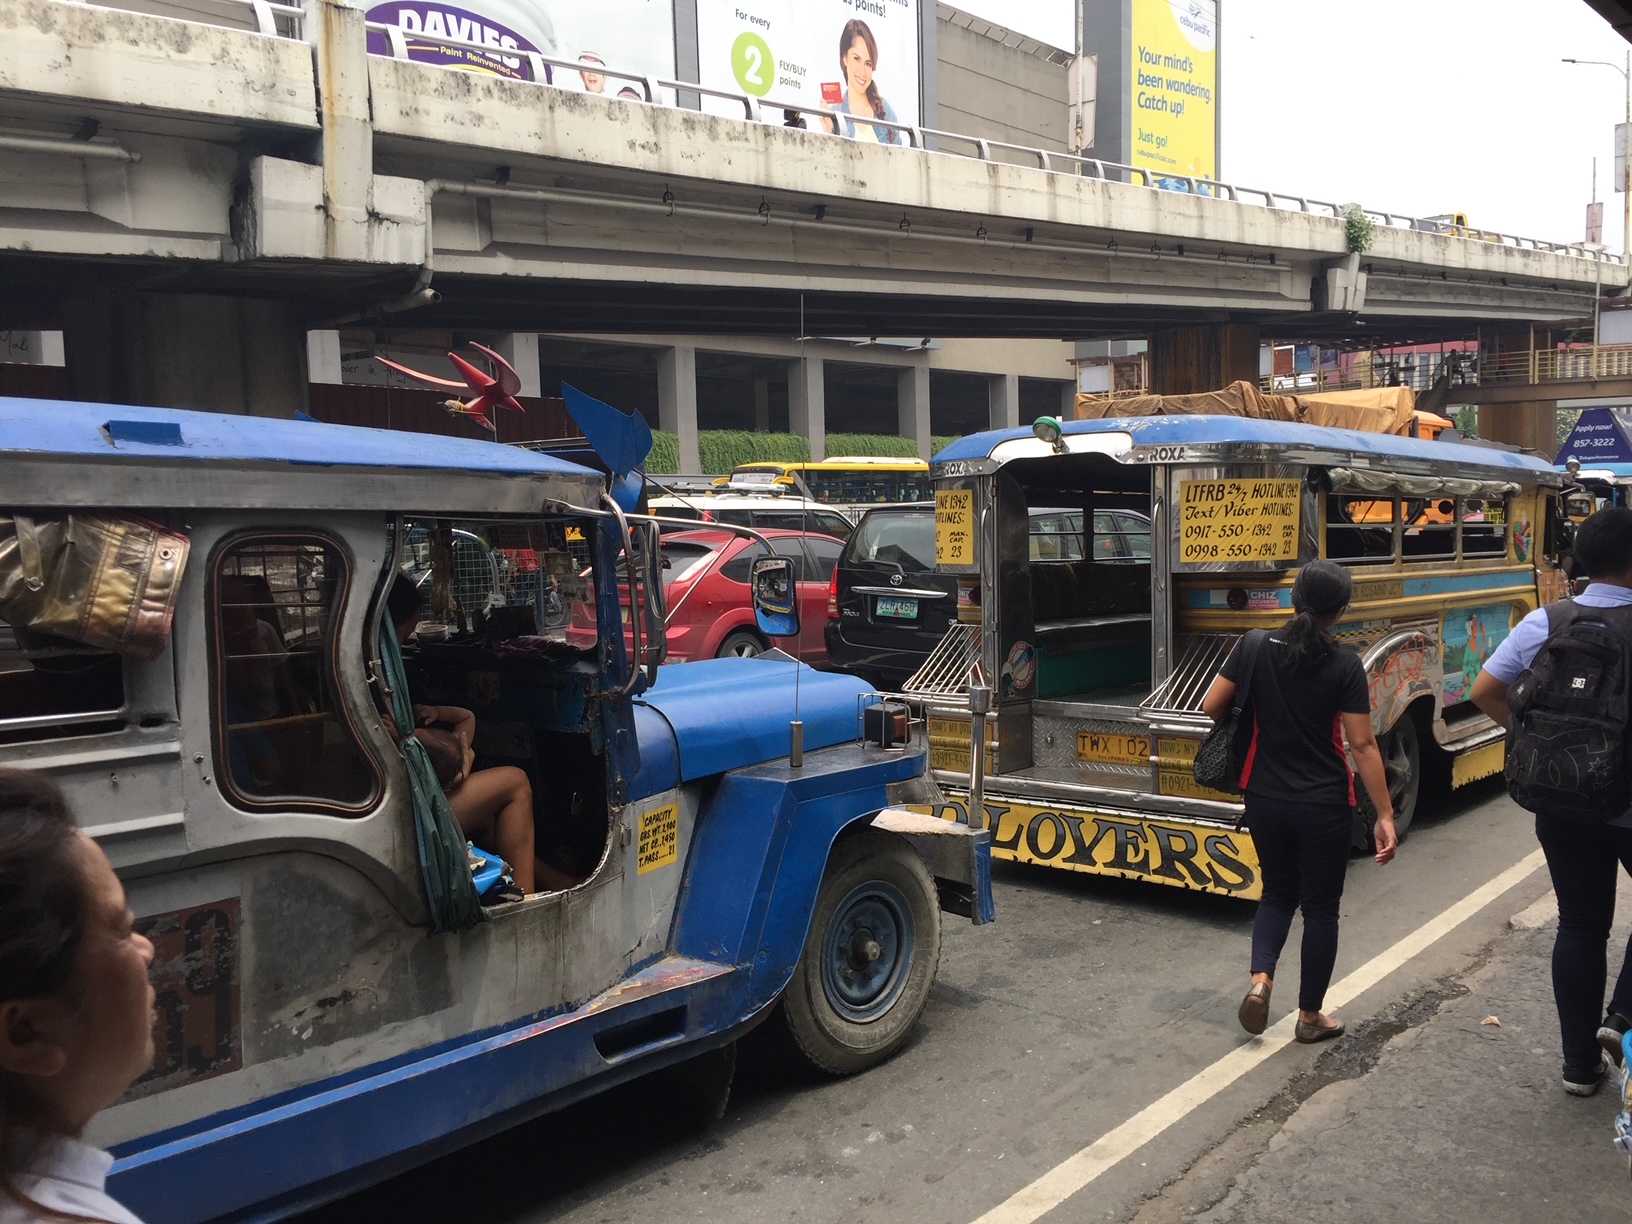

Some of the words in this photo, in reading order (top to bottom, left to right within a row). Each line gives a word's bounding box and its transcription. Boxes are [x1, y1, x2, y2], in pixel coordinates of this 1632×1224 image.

[735, 9, 748, 21] For
[750, 14, 771, 30] every
[399, 9, 520, 69] DAVIES
[440, 46, 463, 58] Paint
[467, 53, 511, 75] Reinvented
[744, 45, 763, 86] 2
[779, 60, 807, 77] FLY/BUY
[1138, 45, 1162, 66] Your
[1163, 53, 1193, 74] mind's
[779, 76, 802, 90] points
[1138, 68, 1163, 89] been
[1166, 79, 1211, 104] wandering.
[1138, 91, 1168, 112] Catch
[1170, 99, 1184, 118] up!
[1138, 128, 1155, 144] Just
[1156, 136, 1168, 149] go!
[1575, 425, 1595, 433] Apply
[1573, 438, 1615, 448] 857-3222
[950, 494, 968, 509] 1342
[1185, 483, 1226, 503] LTFRB
[1227, 483, 1247, 502] 24/7
[1251, 482, 1285, 499] HOTLINE
[1285, 482, 1299, 498] 1342
[1261, 502, 1295, 517] HOTLINES:
[1283, 540, 1291, 555] 23
[1250, 591, 1276, 599] CHIZ
[879, 601, 895, 610] ZLR
[1078, 735, 1110, 753] TWX
[1118, 737, 1148, 757] 102
[644, 808, 673, 827] CAPACITY
[639, 842, 649, 854] NET
